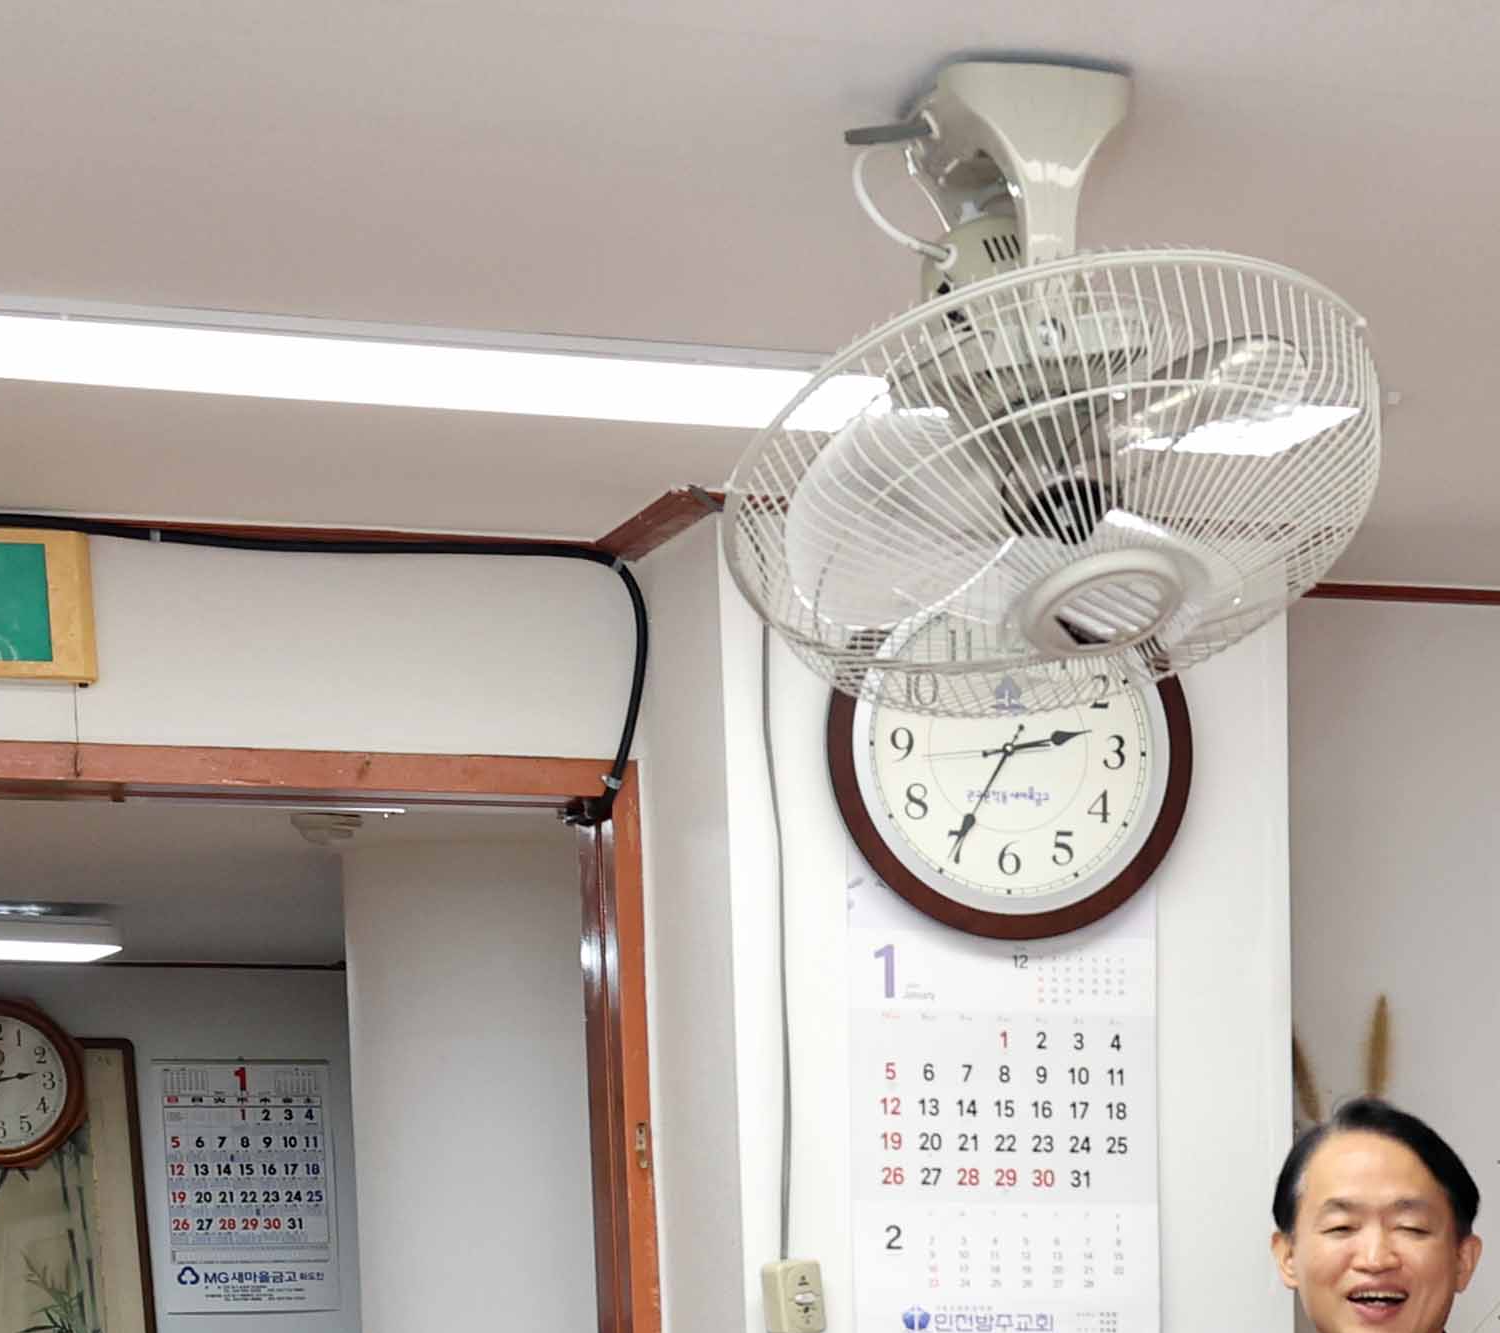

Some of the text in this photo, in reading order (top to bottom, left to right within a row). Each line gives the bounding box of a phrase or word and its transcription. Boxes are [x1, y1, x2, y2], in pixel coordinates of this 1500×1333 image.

[904, 674, 939, 706] 10
[1089, 674, 1110, 708] 2
[890, 727, 915, 763] 9
[1102, 734, 1126, 770] 3
[904, 783, 929, 820] 8
[1087, 789, 1111, 823] 4
[948, 829, 973, 864] 7
[1052, 831, 1074, 866] 5
[998, 840, 1021, 876] 6
[874, 944, 895, 999] 1
[1013, 954, 1028, 969] 12
[16, 1029, 22, 1047] 1
[1000, 1031, 1121, 1051] 1 2 3 4
[34, 1046, 47, 1064] 2
[42, 1072, 55, 1089] 3
[234, 1067, 247, 1091] 1
[886, 1062, 1123, 1085] 5 6 7 8 9 10 11
[36, 1096, 49, 1113] 4
[240, 1108, 314, 1121] 1 2 3 4
[881, 1097, 1126, 1120] 12 13 14 15 16 17 18
[19, 1115, 32, 1132] 5
[171, 1136, 317, 1148] 5 6 7 8 9 10 11
[881, 1132, 1127, 1154] 19 20 21 22 23 24 25
[170, 1163, 320, 1176] 12 13 14 15 16 17 18
[882, 1167, 1090, 1188] 26 27 28 29 30 31
[172, 1190, 323, 1203] 19 20 21 22 23 24 25
[173, 1218, 302, 1231] 26 27 28 29 30 31
[885, 1225, 903, 1250] 2
